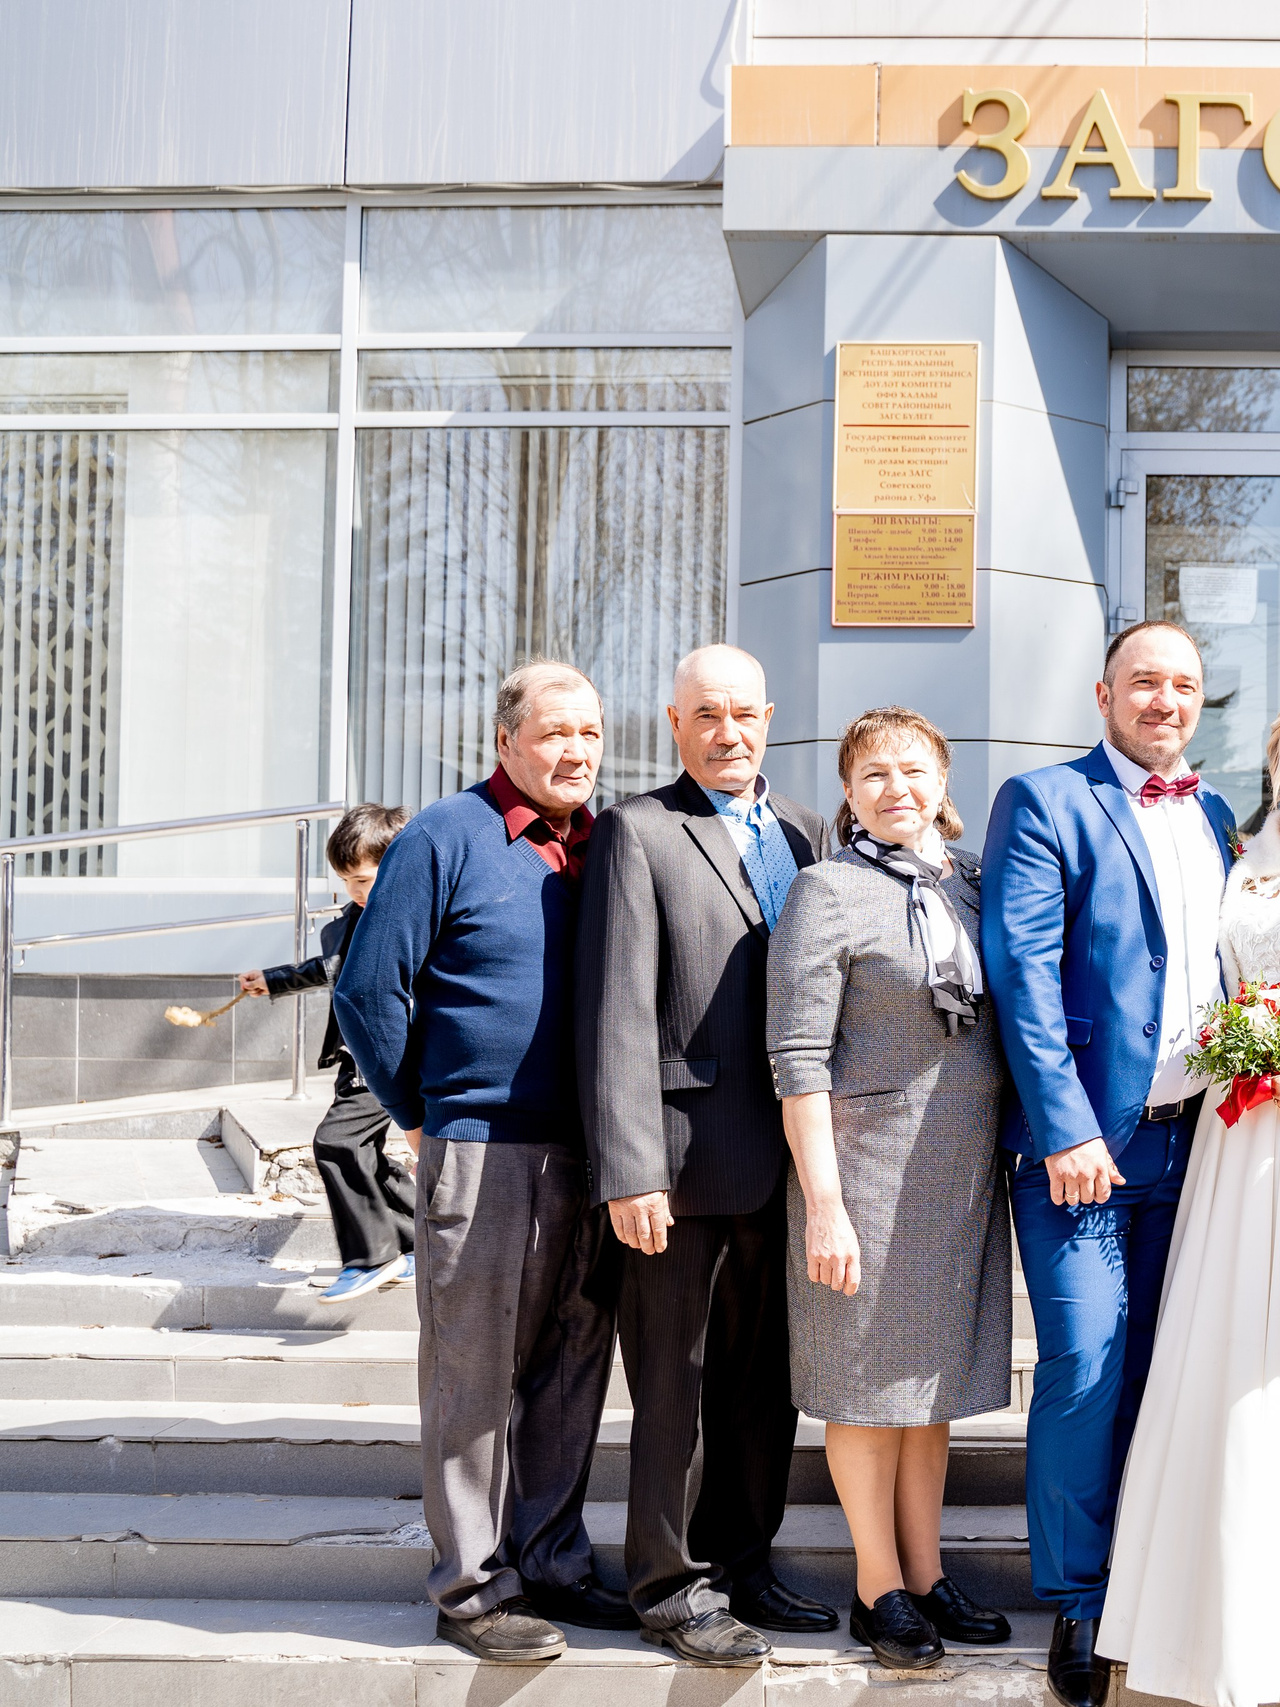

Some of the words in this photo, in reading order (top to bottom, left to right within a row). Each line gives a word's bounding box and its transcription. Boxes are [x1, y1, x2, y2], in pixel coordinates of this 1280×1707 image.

[842, 370, 889, 378] ЮСТИЦИЯ
[846, 433, 926, 443] Государственный
[845, 445, 899, 455] Республики
[901, 445, 968, 455] Башкортостан
[877, 458, 905, 466] делам
[907, 458, 949, 466] юстиции
[878, 469, 907, 478] Отдел
[909, 469, 933, 477] ЗАГС
[879, 481, 932, 490] Советского
[874, 493, 907, 503] района
[918, 493, 937, 503] Уфа
[860, 572, 900, 581] РЕЖИМ
[903, 572, 950, 581] РАБОТЫ:
[884, 583, 911, 591] суббота
[847, 591, 879, 599] Перерыв
